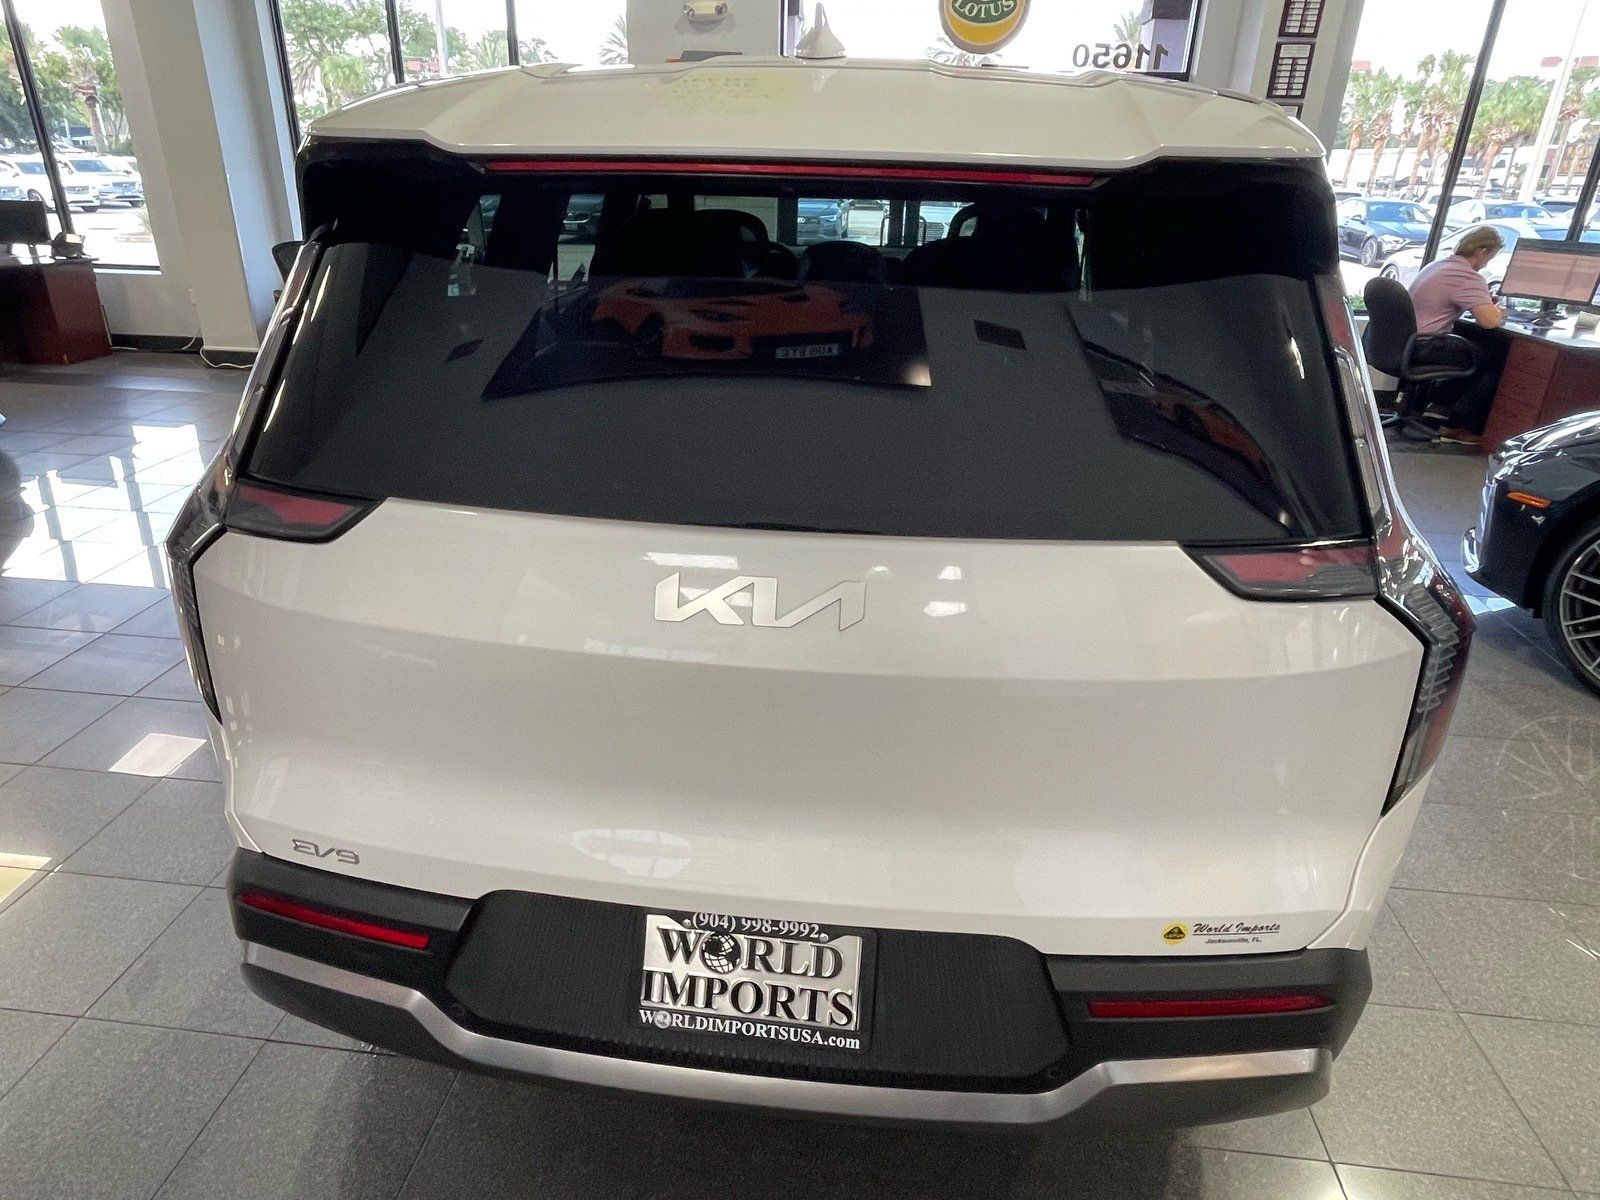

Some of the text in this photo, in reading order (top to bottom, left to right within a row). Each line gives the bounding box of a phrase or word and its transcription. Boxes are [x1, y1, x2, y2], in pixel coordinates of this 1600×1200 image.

[953, 0, 1015, 18] LOTUS
[654, 571, 867, 631] KIA
[292, 839, 360, 865] EV9
[692, 912, 820, 939] (904) 998-9992
[1193, 922, 1281, 934] World Imports
[657, 926, 845, 980] WORLD
[641, 969, 855, 1027] IMPORTS
[638, 1009, 861, 1049] WORLDIMPORTSUSA.com
